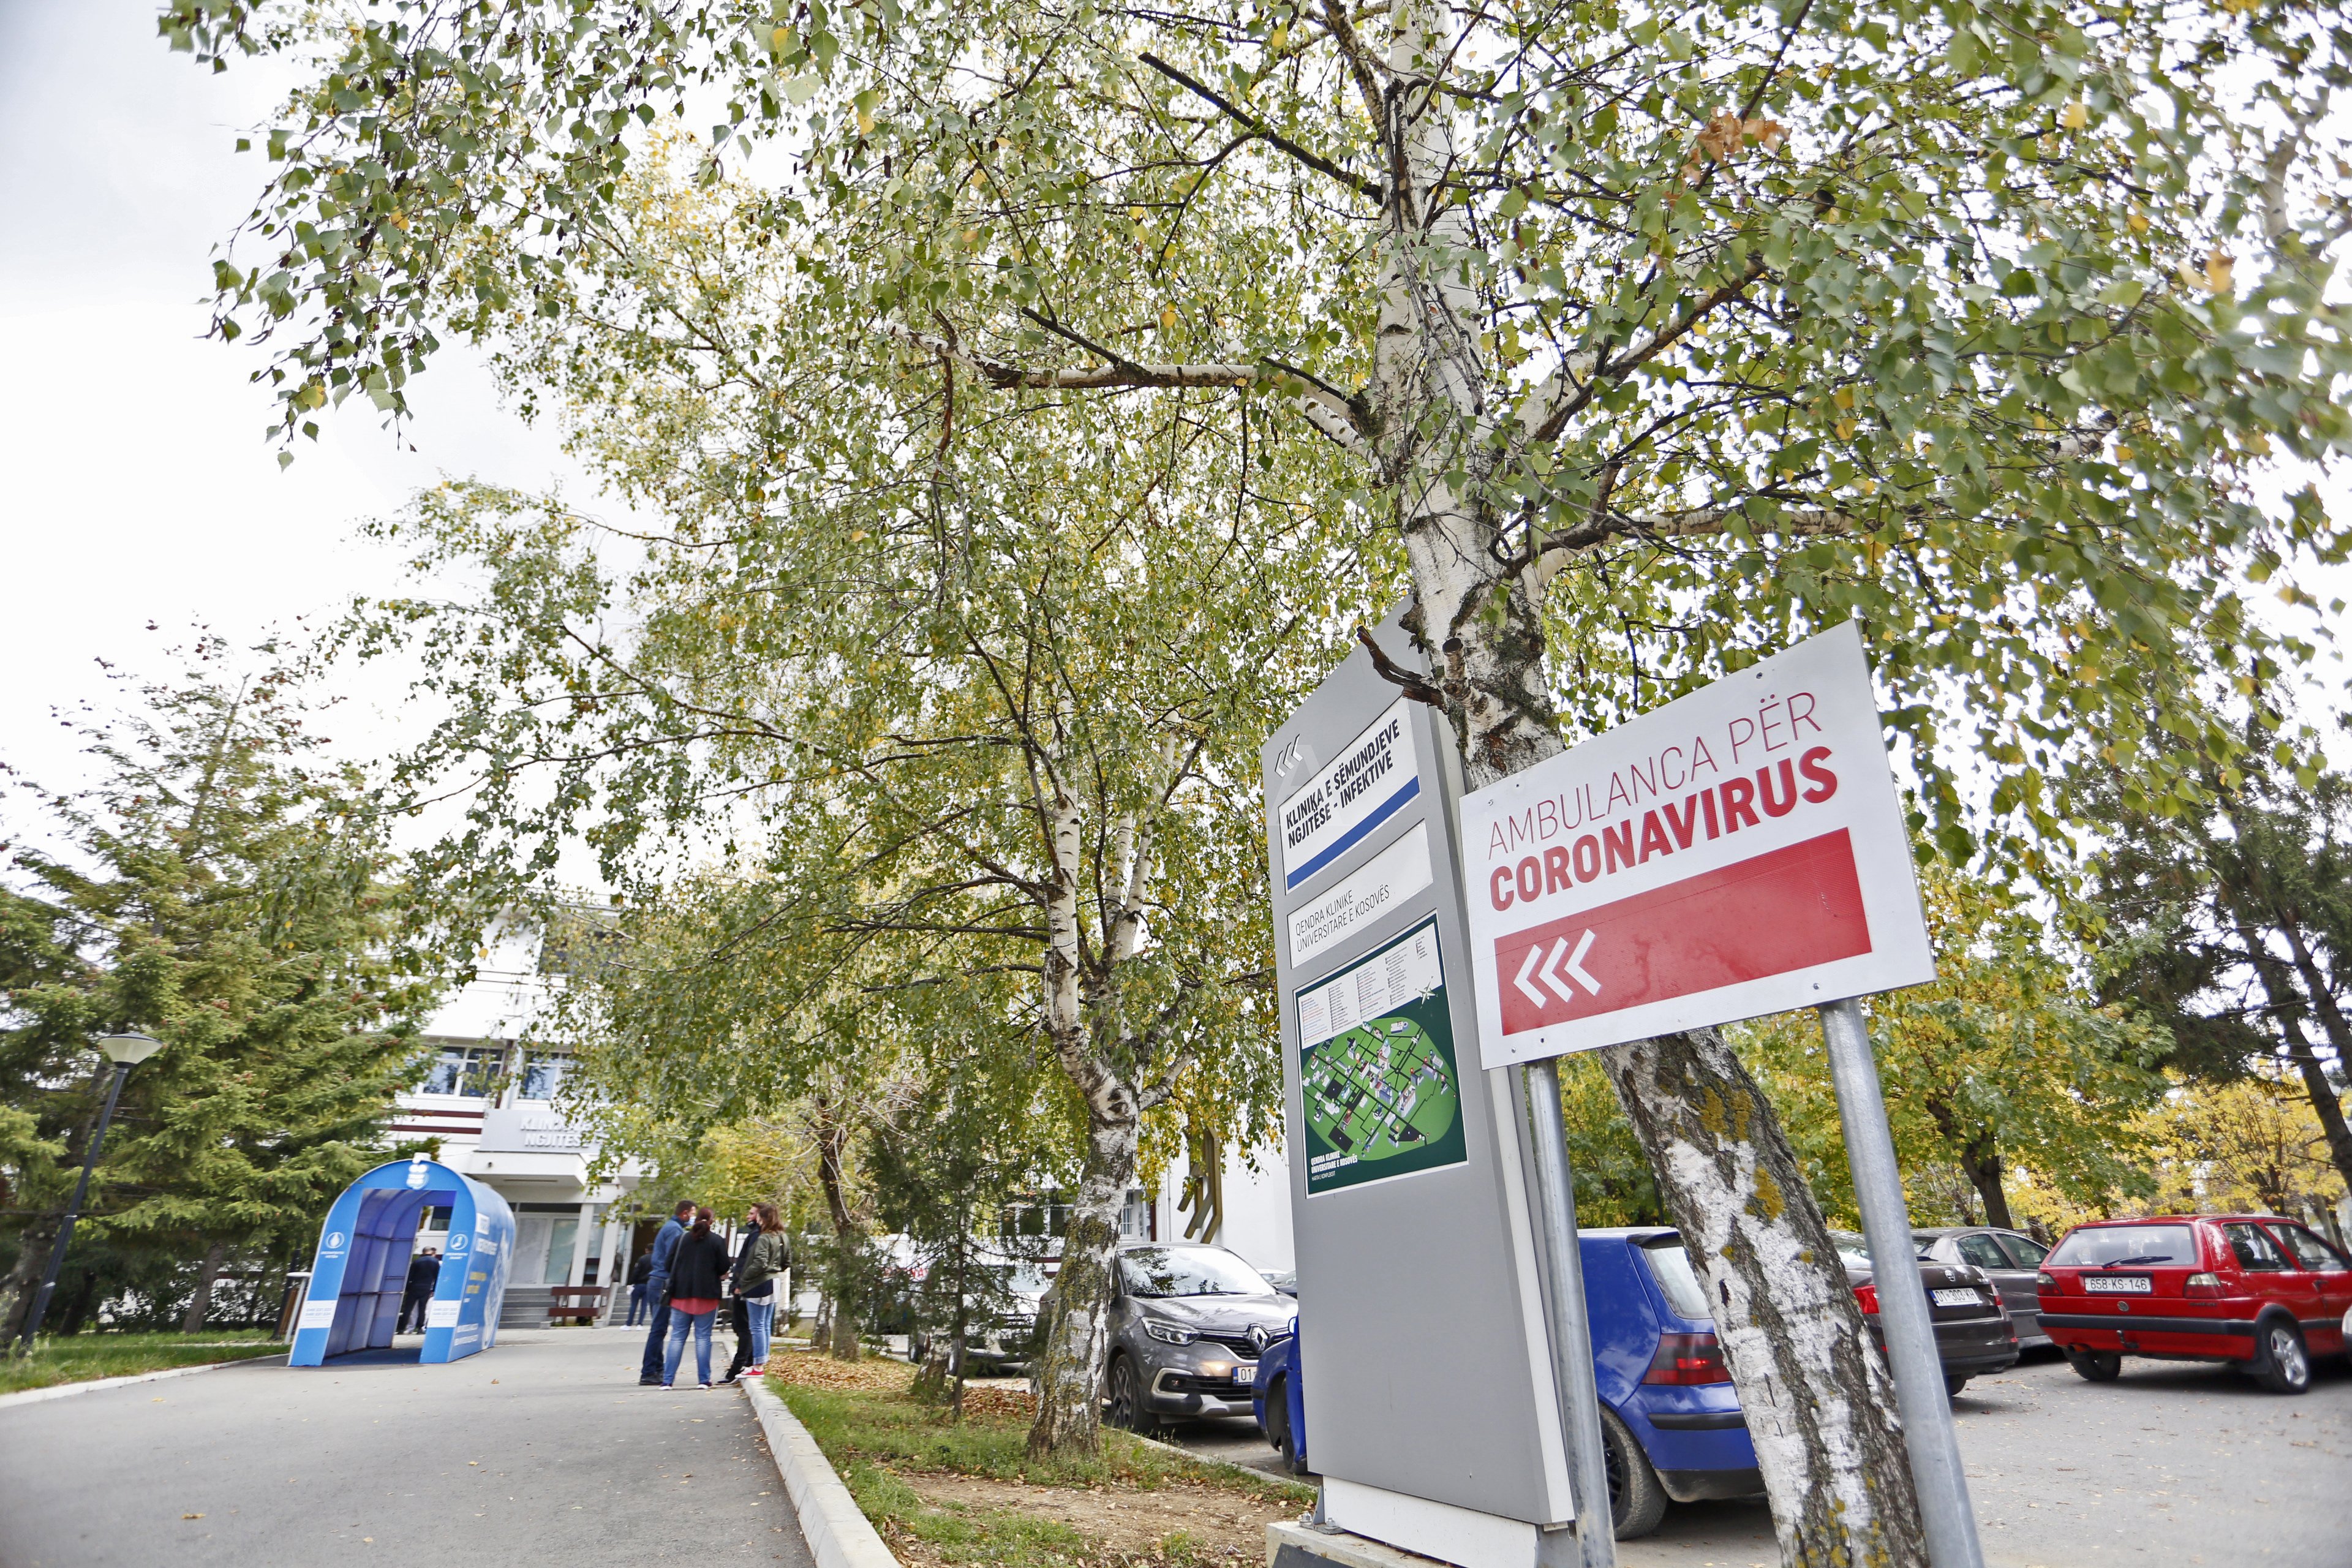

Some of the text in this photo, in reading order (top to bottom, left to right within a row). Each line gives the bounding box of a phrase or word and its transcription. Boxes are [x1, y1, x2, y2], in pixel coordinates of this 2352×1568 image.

[1286, 718, 1400, 830] KLINIKA E SËMUNDJEVE
[1340, 749, 1393, 809] INFEKTIVE
[1488, 692, 1823, 860] AMBULANCA PËR
[1490, 746, 1839, 912] CORONAVIRUS
[1295, 889, 1353, 937] QENDRA KLINIKE
[1297, 884, 1390, 952] UNIVERSITARE E KOSOVËS
[1311, 1151, 1340, 1166] QENDRA KLINIKE
[1311, 1153, 1358, 1174] UNIVERSITARE E KOSOVËS
[2090, 1278, 2147, 1290] 658-KS-146
